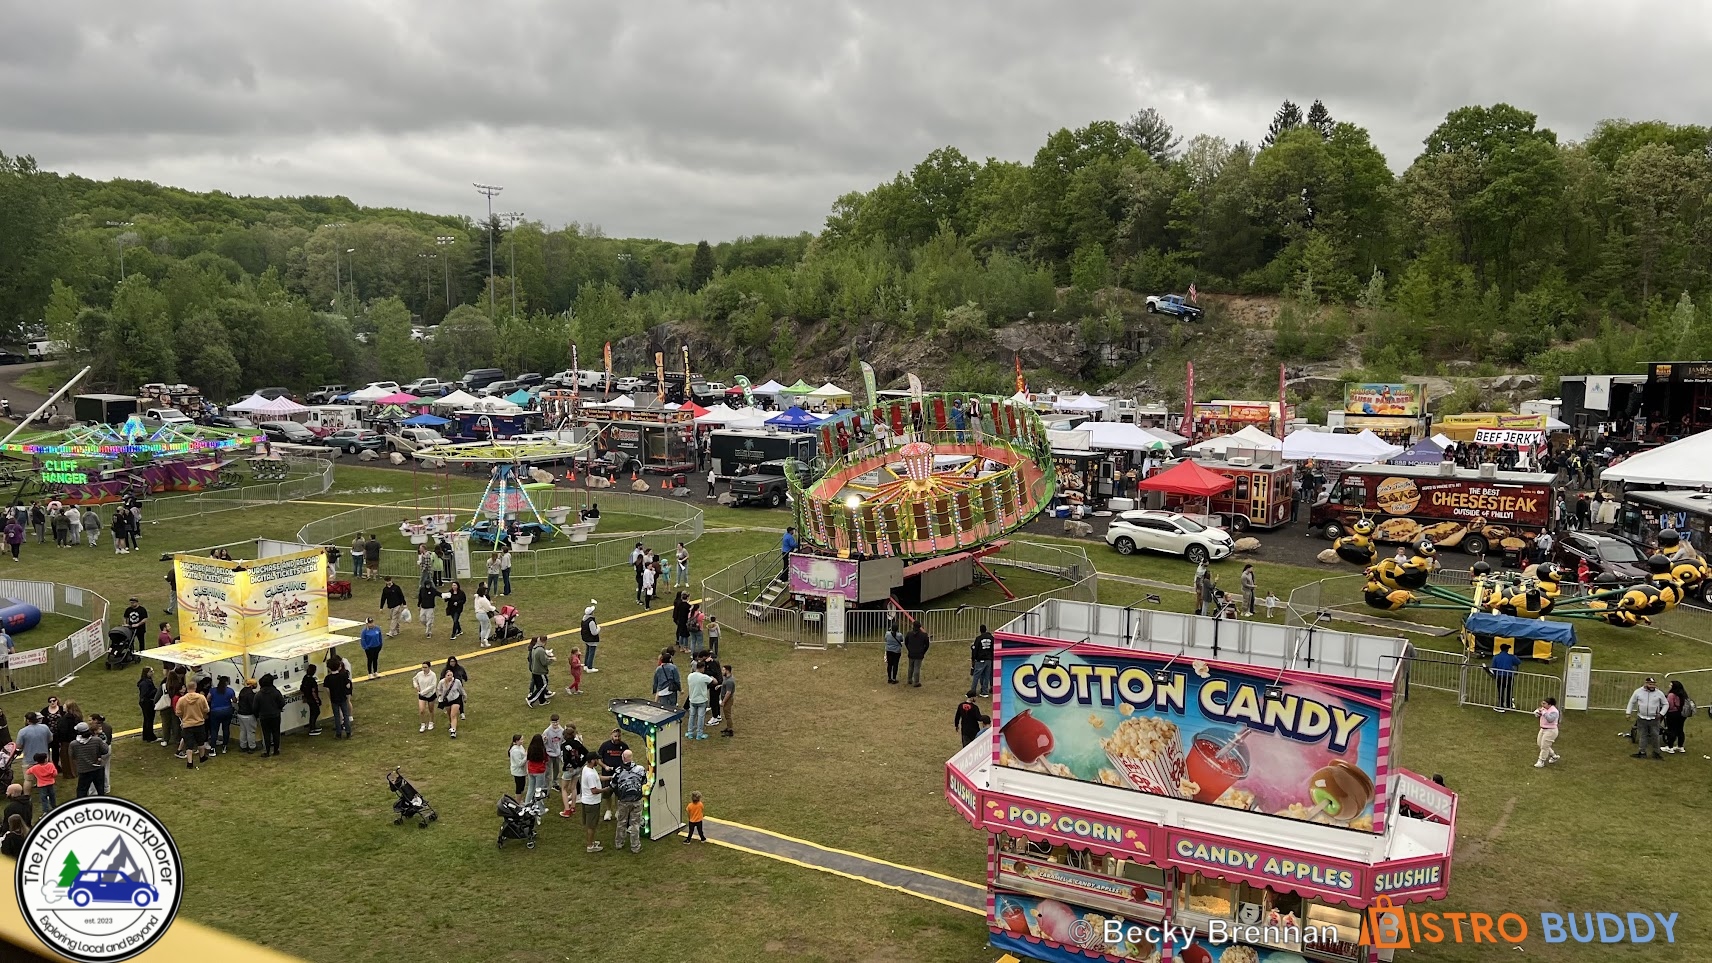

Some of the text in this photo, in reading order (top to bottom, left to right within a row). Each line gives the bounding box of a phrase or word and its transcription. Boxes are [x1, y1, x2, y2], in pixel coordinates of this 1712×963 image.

[1182, 368, 1194, 433] POUTINE
[1476, 431, 1540, 445] BEEF JERKY
[45, 460, 78, 471] CLIFF
[41, 472, 88, 484] HANGER
[1482, 488, 1500, 496] BEST
[1432, 492, 1537, 513] CHEESESTEAK
[1454, 508, 1480, 516] OUTSIDE
[1491, 511, 1513, 519] PHILLY!
[180, 562, 205, 574] PURCHASE
[247, 556, 320, 576] PURCHASE AND RELOAD
[250, 564, 318, 584] DIGITAL TICKETS HERE
[182, 571, 201, 580] DIGITAL
[840, 573, 857, 587] UP
[192, 586, 226, 601] CUSHING
[264, 581, 306, 598] CUSHING
[270, 616, 306, 628] AMUSEMENTS
[1012, 664, 1187, 712] COTTON
[1198, 678, 1368, 749] CANDY
[950, 774, 976, 810] SLUSHIE
[1008, 805, 1123, 843] POP CORN
[1176, 840, 1354, 890] CANDY APPLES
[1039, 872, 1066, 883] CARAMEL
[1074, 879, 1095, 889] CANDY
[1096, 884, 1120, 894] APPLES
[1374, 866, 1440, 892] SLUSHIE
